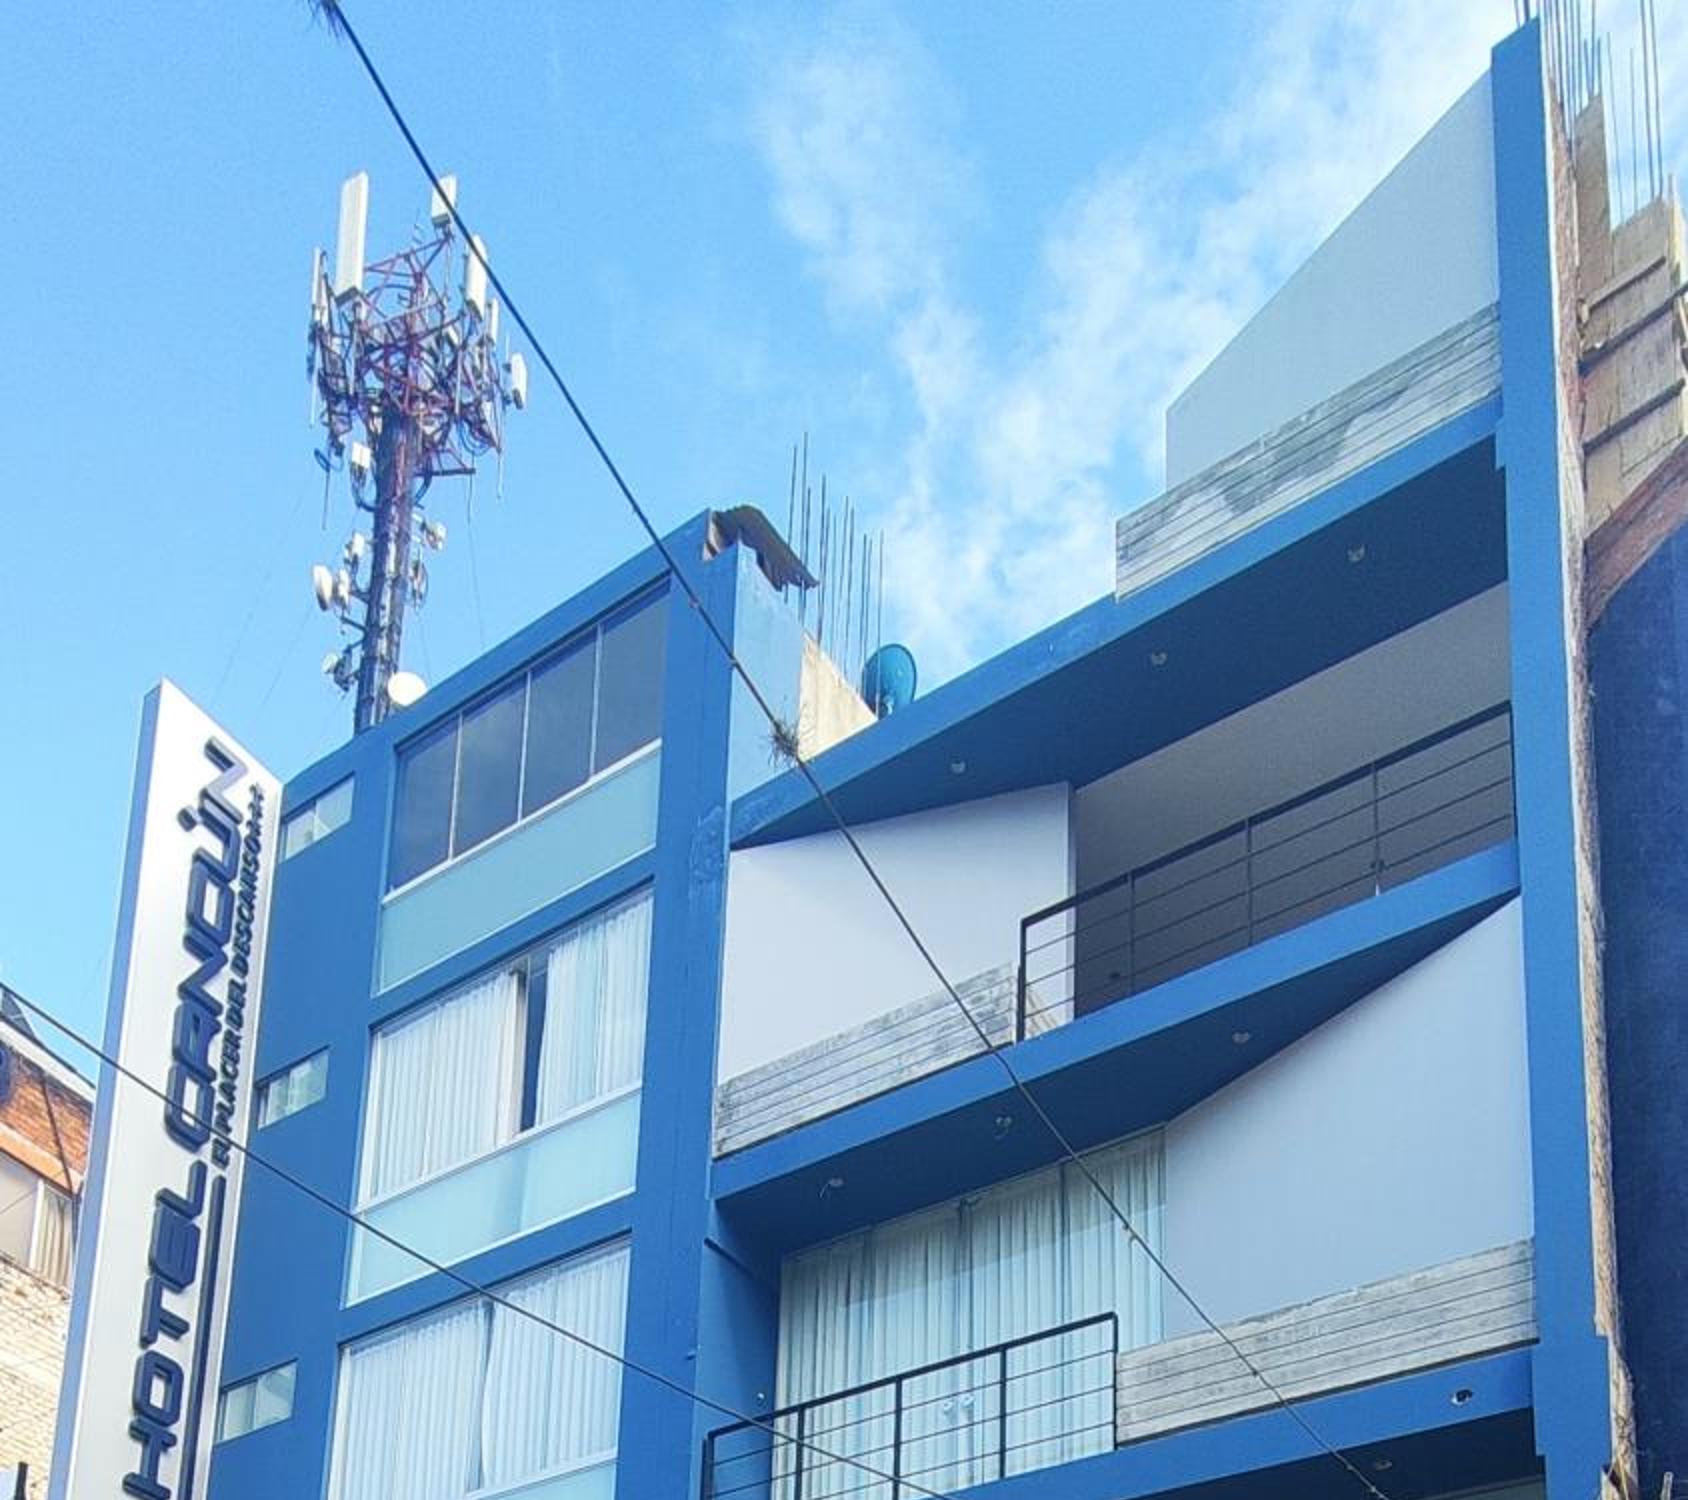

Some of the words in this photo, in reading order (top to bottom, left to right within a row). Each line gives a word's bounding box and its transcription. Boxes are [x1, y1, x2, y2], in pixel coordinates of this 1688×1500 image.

[224, 979, 247, 1031] DEL
[214, 1030, 243, 1137] PLACER
[211, 1140, 231, 1170] EL
